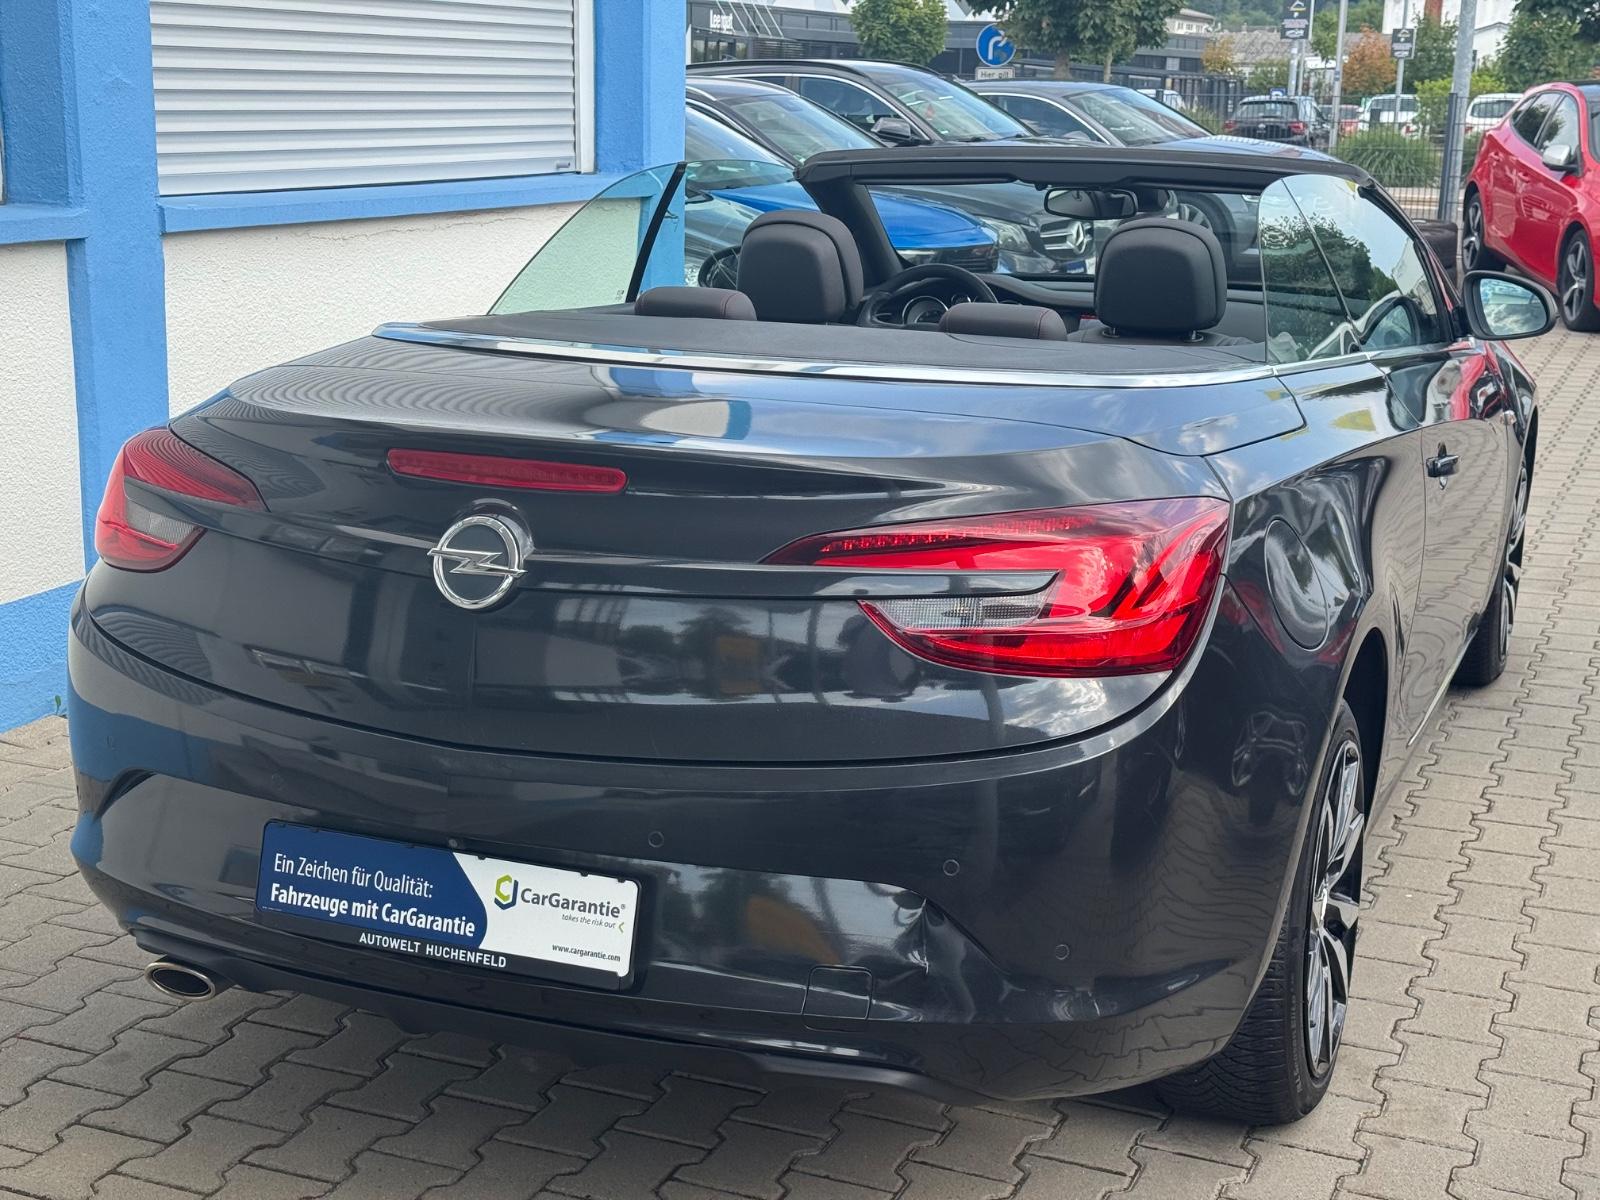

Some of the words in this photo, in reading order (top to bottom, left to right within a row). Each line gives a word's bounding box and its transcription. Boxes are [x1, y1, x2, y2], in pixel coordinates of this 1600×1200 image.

[274, 853, 294, 874] Ein
[297, 857, 348, 883] Zeichen
[351, 866, 371, 887] für
[374, 870, 434, 899] Qualität:
[271, 883, 348, 917] Fahrzeuge
[351, 900, 378, 920] mit
[381, 903, 476, 937] CarGarantie
[562, 913, 579, 924] takes
[580, 916, 591, 925] the
[592, 918, 604, 926] risk
[605, 921, 616, 929] out
[359, 932, 421, 952] AUTOWELT
[425, 944, 507, 968] HUCHENFELD
[552, 944, 621, 962] www.cargarantie.com
